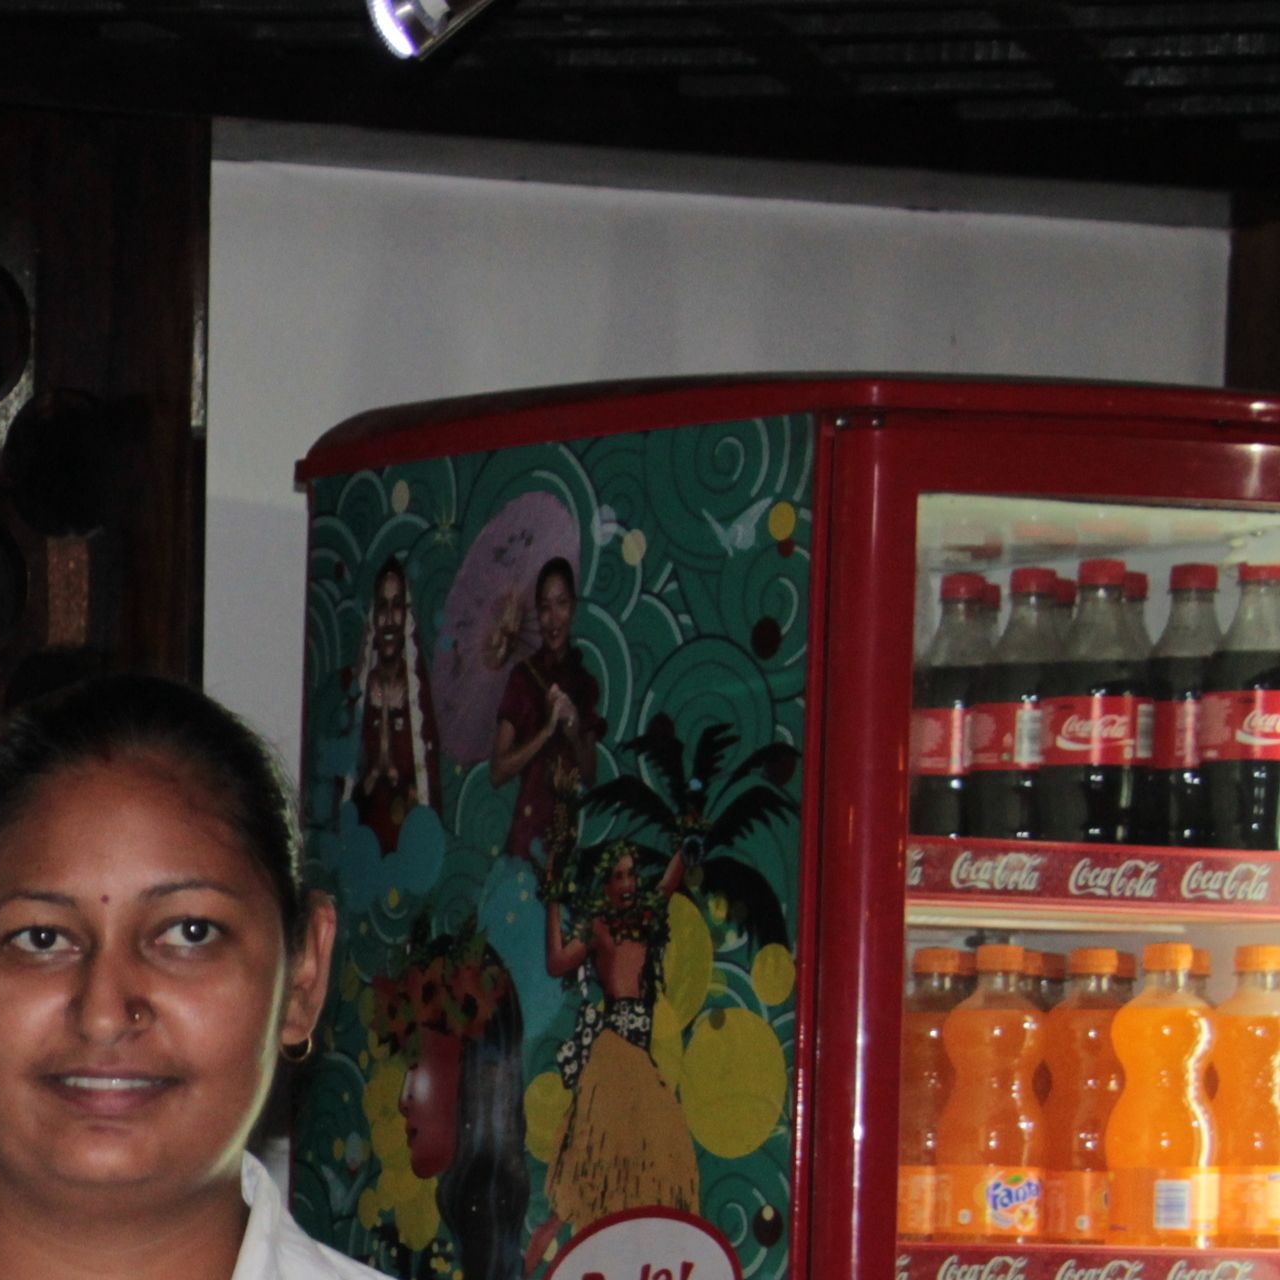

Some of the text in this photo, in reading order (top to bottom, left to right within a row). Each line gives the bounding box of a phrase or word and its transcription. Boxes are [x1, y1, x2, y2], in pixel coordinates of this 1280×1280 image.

[1061, 714, 1129, 739] Coca-Cola
[950, 851, 1046, 891] Coca-Cola
[1068, 857, 1160, 898] Coca-Cola
[1180, 861, 1270, 900] Coca-Cola
